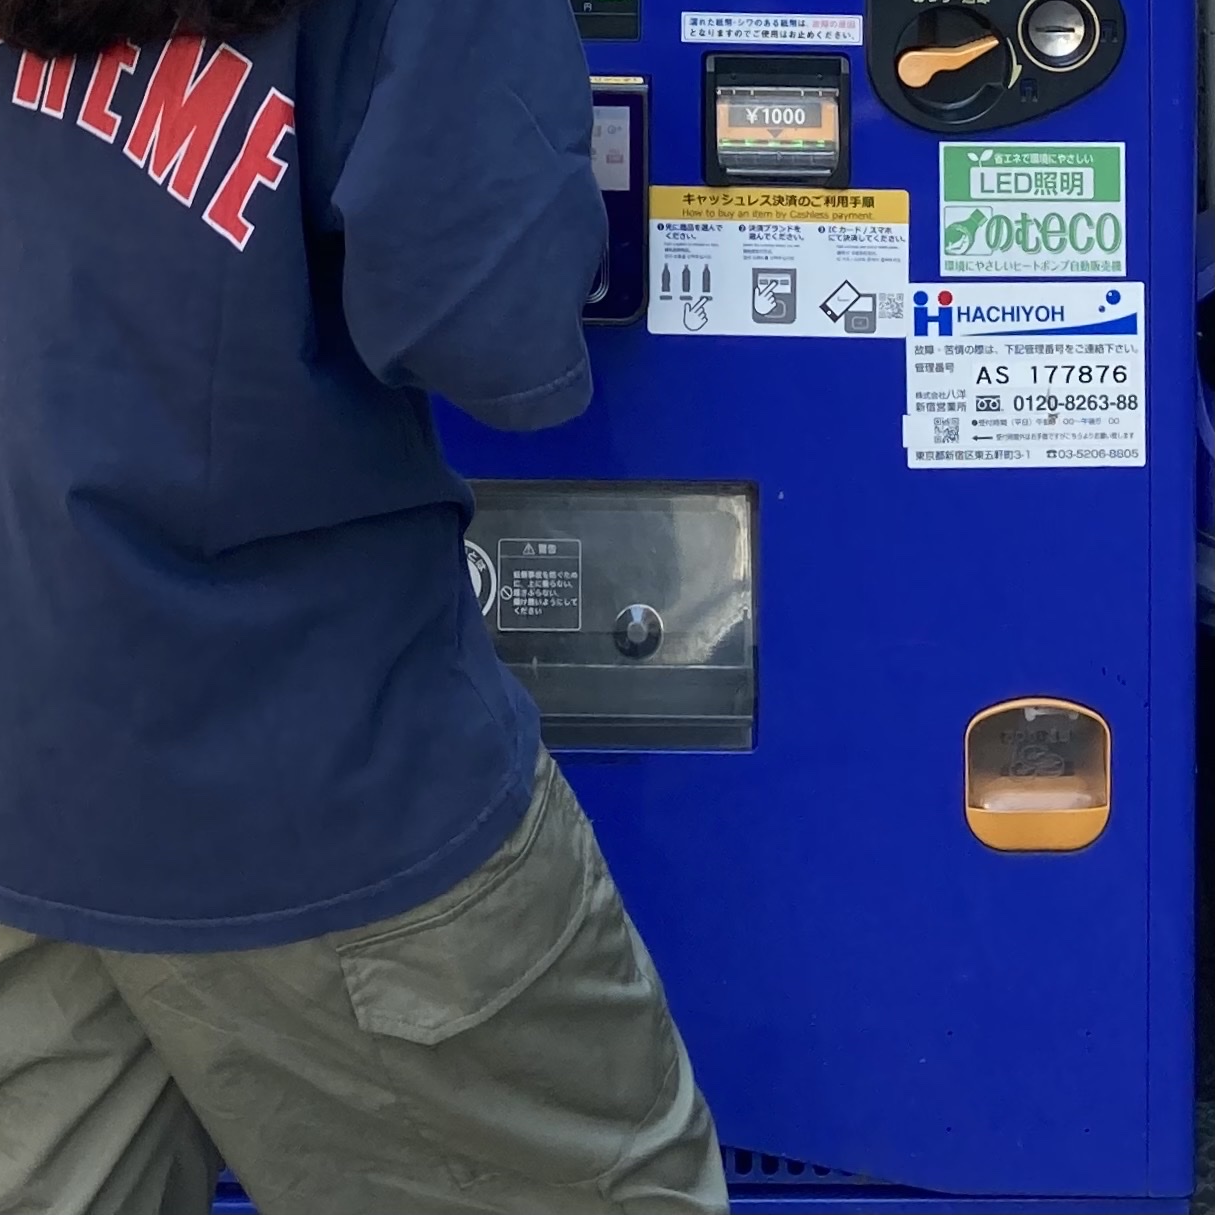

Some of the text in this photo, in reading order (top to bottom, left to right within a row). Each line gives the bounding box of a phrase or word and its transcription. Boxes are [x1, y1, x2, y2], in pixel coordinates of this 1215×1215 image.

[584, 3, 592, 12] 円
[746, 107, 806, 125] ¥1000
[994, 153, 1094, 164] 省エネで環境にやさしい
[980, 171, 1084, 196] LED照明
[682, 193, 875, 208] キャッシュレス決済のご利用手順
[682, 208, 703, 217] How
[706, 209, 714, 217] to
[718, 209, 734, 219] buy
[752, 210, 773, 218] item
[776, 210, 787, 220] by
[790, 211, 829, 219] Cashless
[832, 213, 873, 221] payment
[748, 225, 802, 233] 決済ブランドを
[870, 226, 892, 234] スマホ
[985, 212, 1122, 255] のむeco
[666, 232, 697, 240] ください。
[748, 233, 805, 241] 選んでください。
[828, 234, 906, 243] にて決済してください。
[944, 260, 1122, 273] 環境にやさしいヒートポンプ自動販売機
[957, 306, 1064, 323] HACHIYOH
[914, 345, 1138, 355] 故障・苦情の際は、下記管理番号をご連絡下さい。
[915, 363, 1128, 384] 管理番号 AS 177876
[916, 390, 967, 400] 株式会社八洋
[916, 394, 1138, 412] 新宿営業所 0120-8263-88
[916, 449, 1139, 461] 東京都新宿区東五軒町3-1 03-5206-8805
